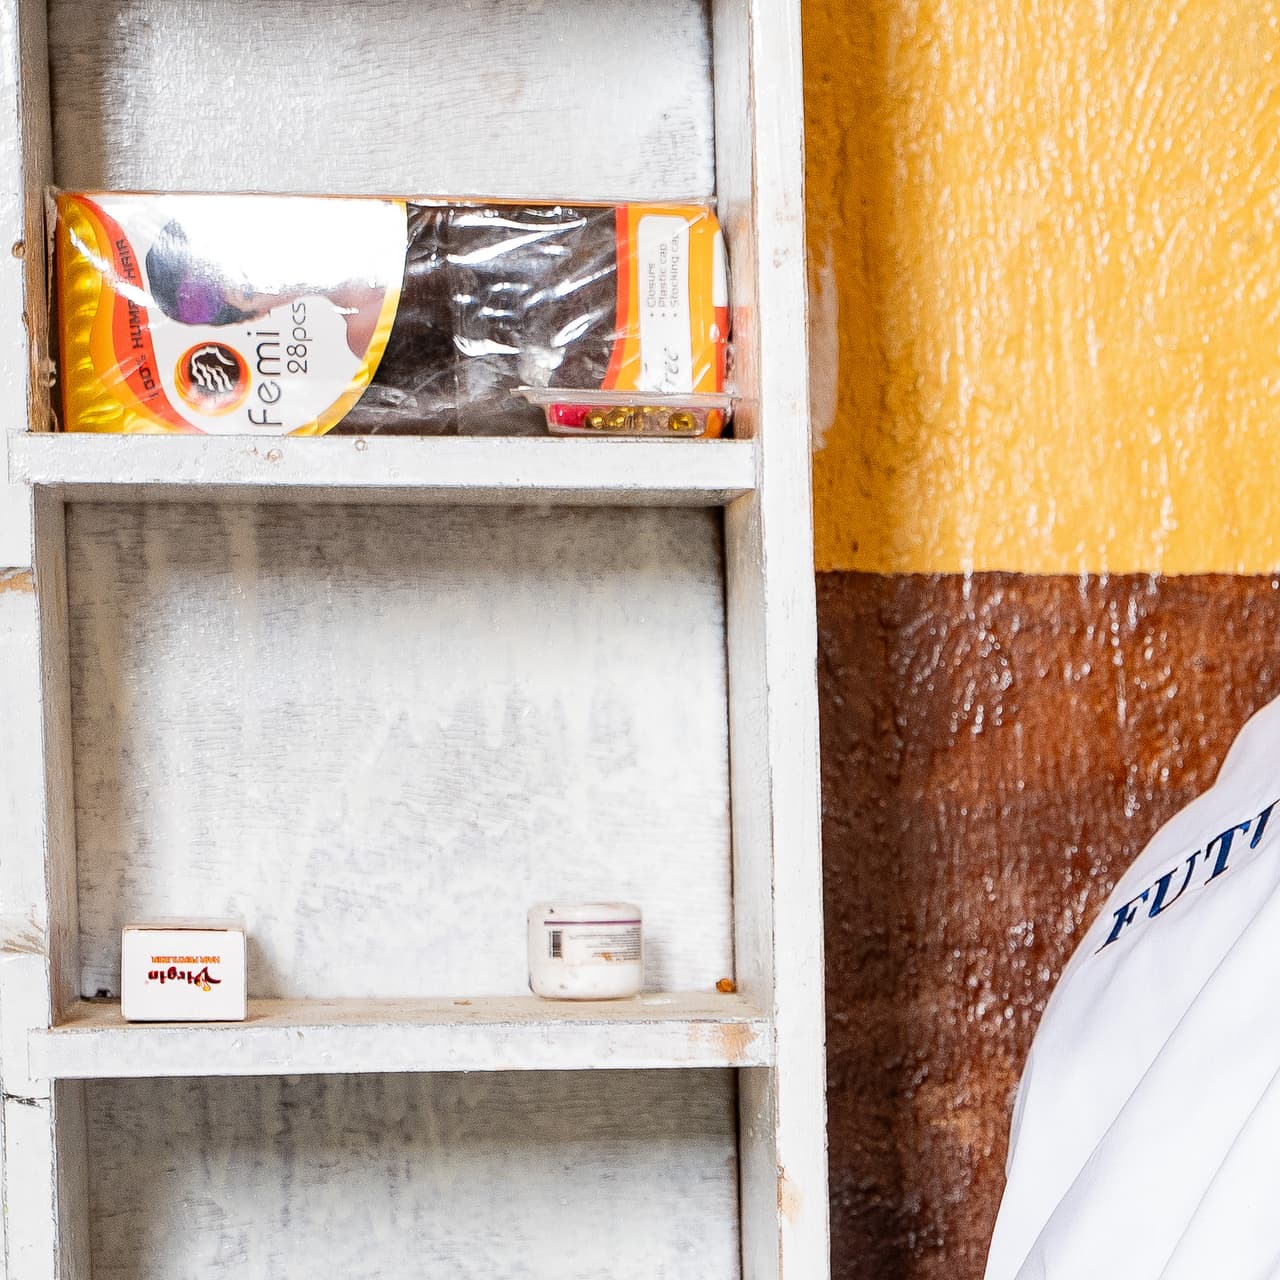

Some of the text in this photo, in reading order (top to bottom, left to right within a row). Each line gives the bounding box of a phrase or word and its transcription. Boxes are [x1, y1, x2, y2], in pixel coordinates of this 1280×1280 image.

[115, 239, 136, 280] HAIR
[286, 302, 313, 374] 28pcs
[147, 966, 222, 988] Virgin
